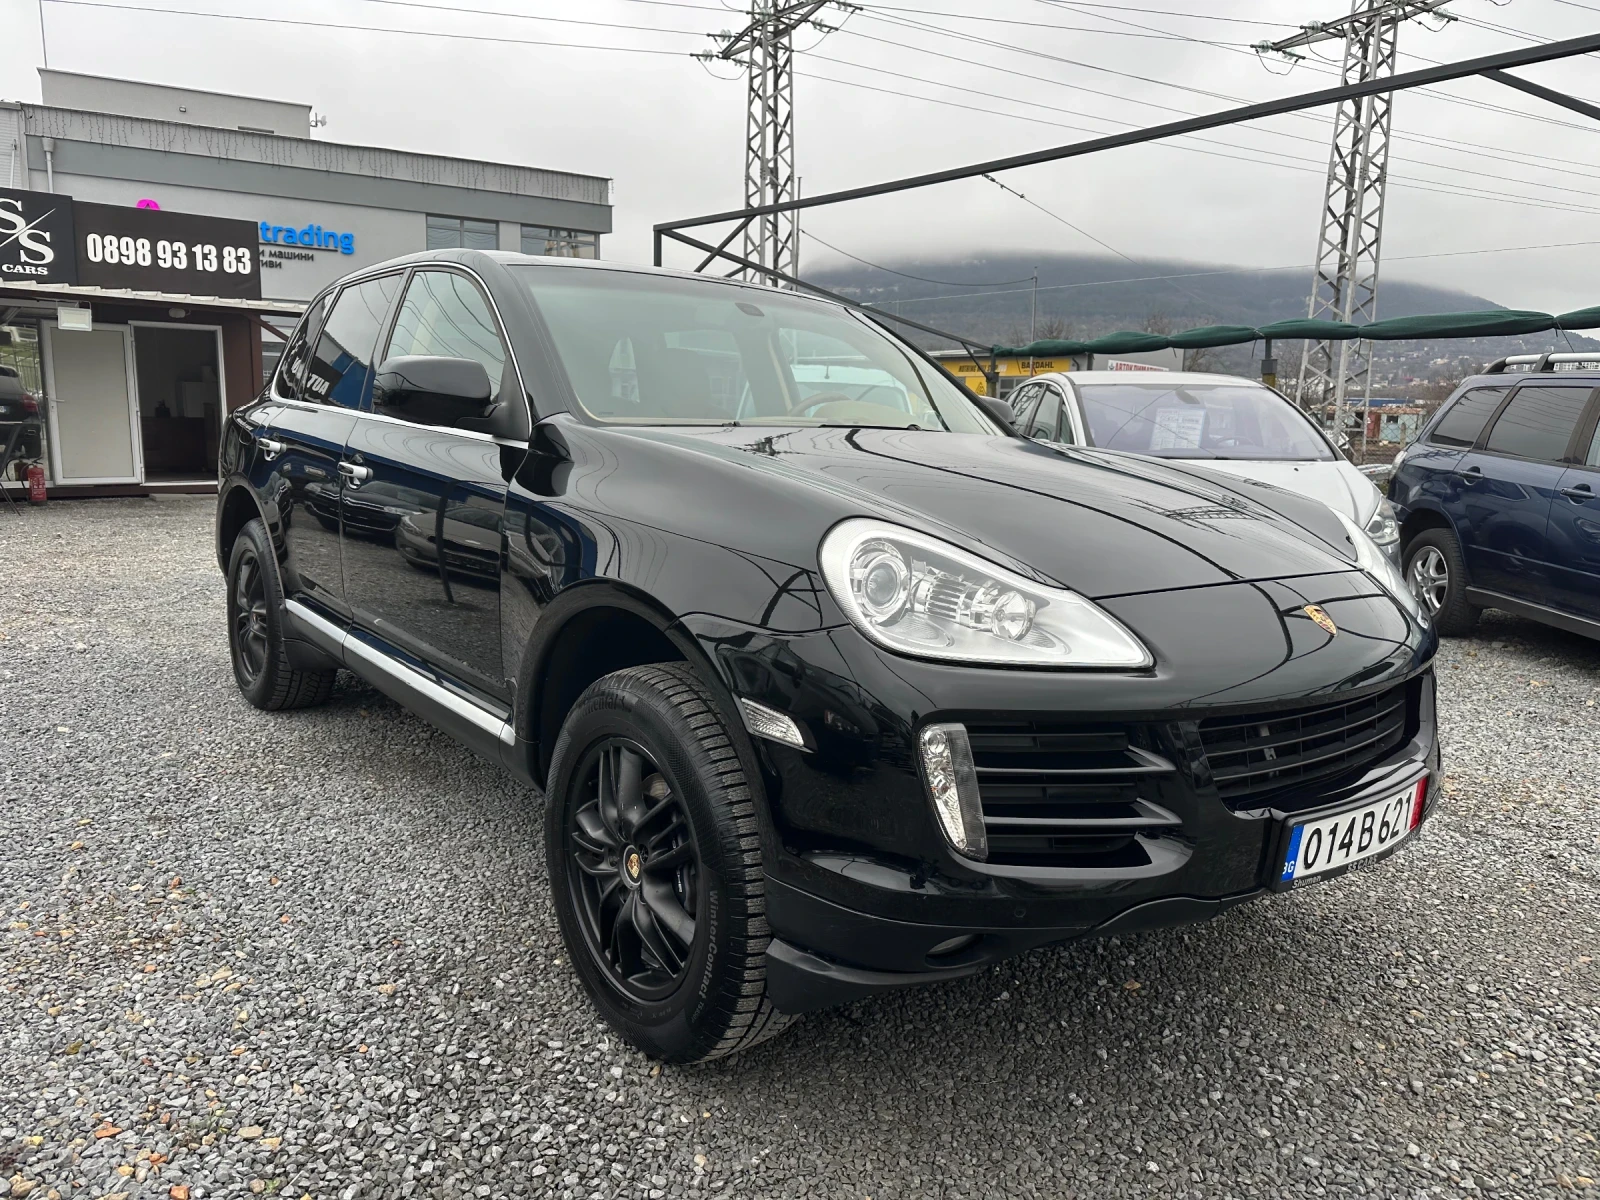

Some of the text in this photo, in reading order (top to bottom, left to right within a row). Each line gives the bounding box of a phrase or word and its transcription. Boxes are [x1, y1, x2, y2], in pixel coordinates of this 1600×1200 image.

[260, 221, 355, 255] trading
[86, 233, 252, 275] 0898 93 13 83
[268, 250, 314, 262] машини
[1, 264, 48, 275] CARS
